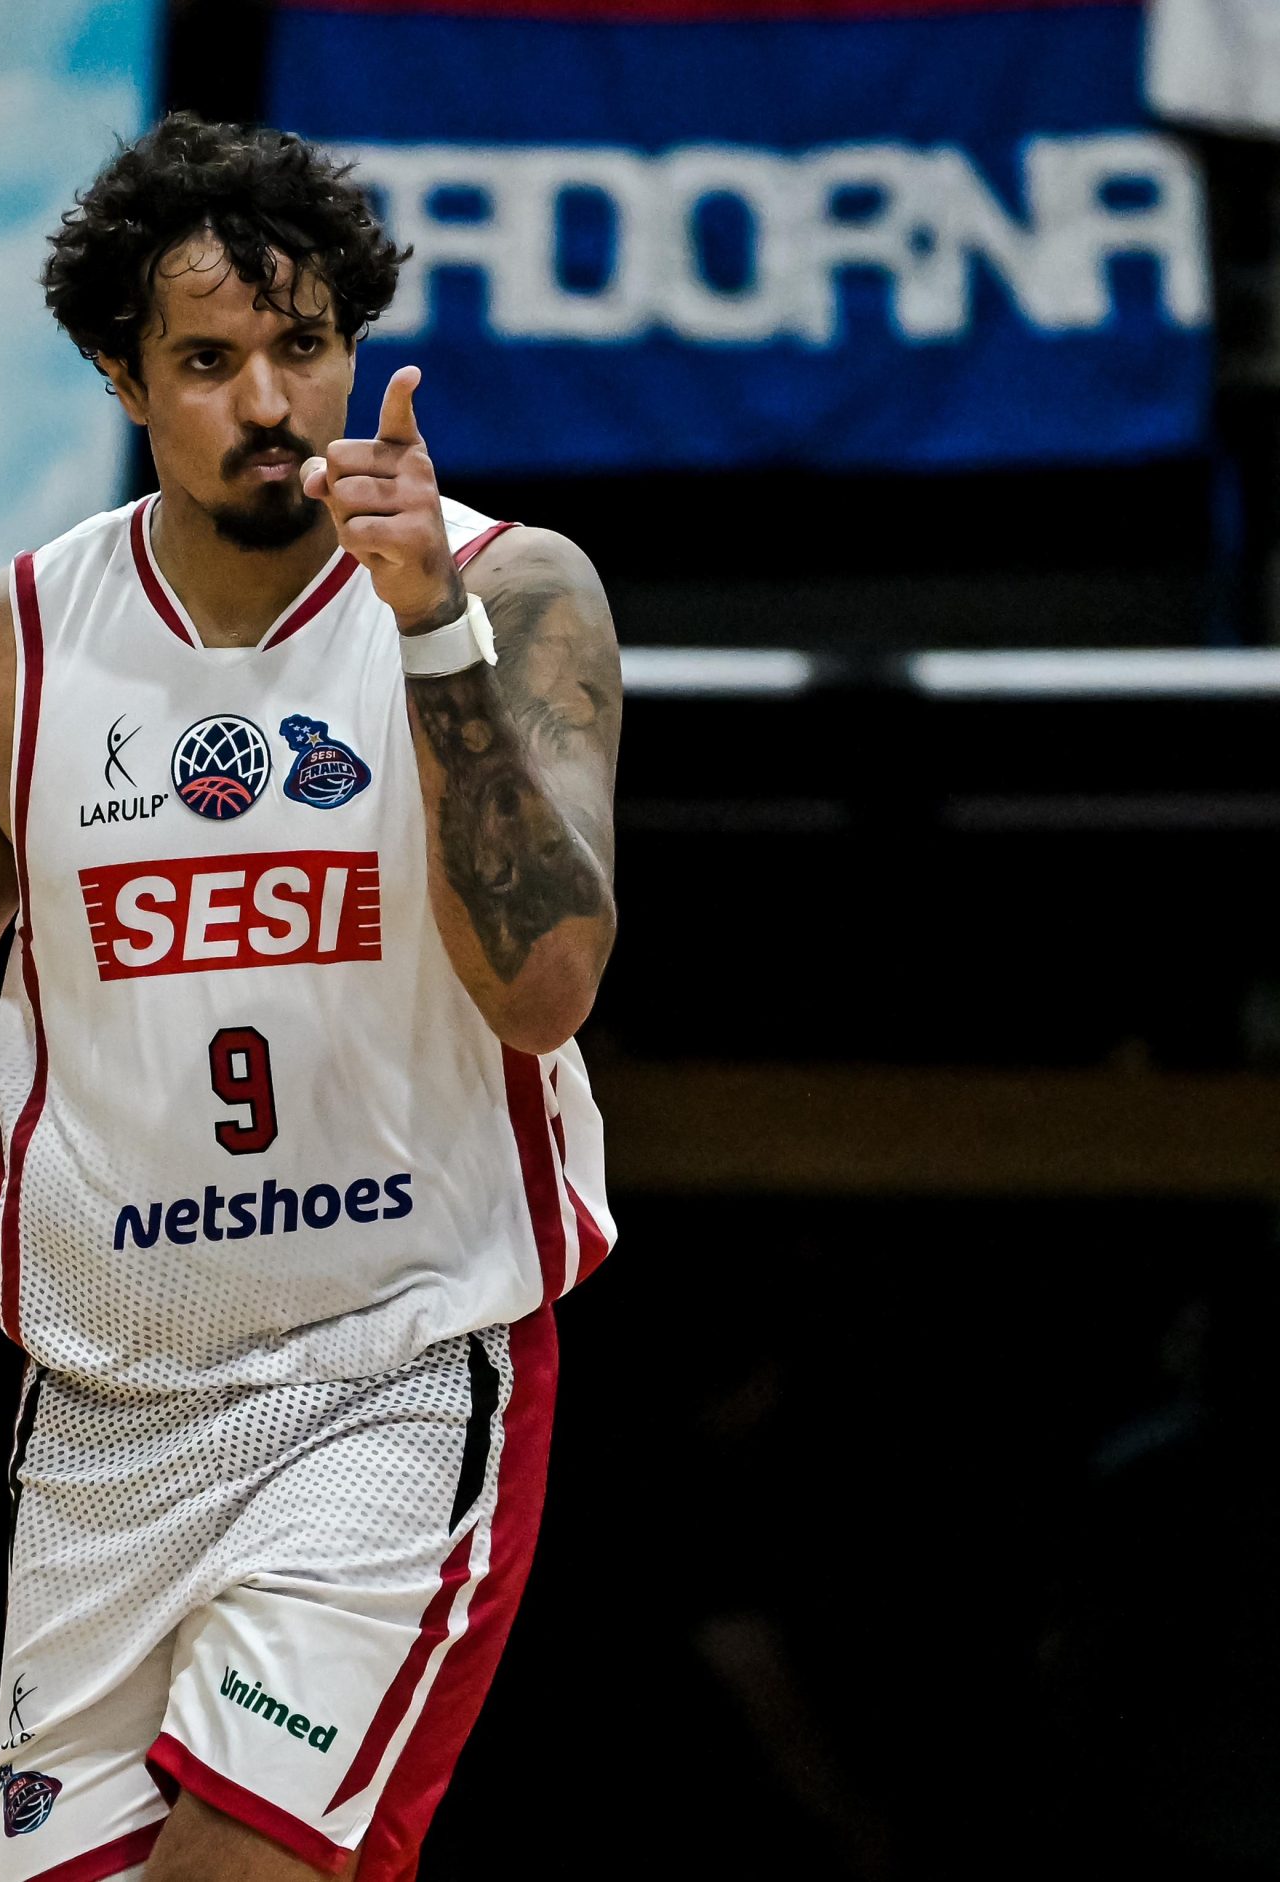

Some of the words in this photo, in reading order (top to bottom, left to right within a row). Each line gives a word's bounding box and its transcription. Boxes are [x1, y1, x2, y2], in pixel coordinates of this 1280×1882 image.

[299, 761, 357, 785] FRANCA
[311, 750, 336, 763] SESI
[112, 866, 349, 968] SESI
[208, 1025, 279, 1156] 9
[219, 1665, 339, 1754] Unimed
